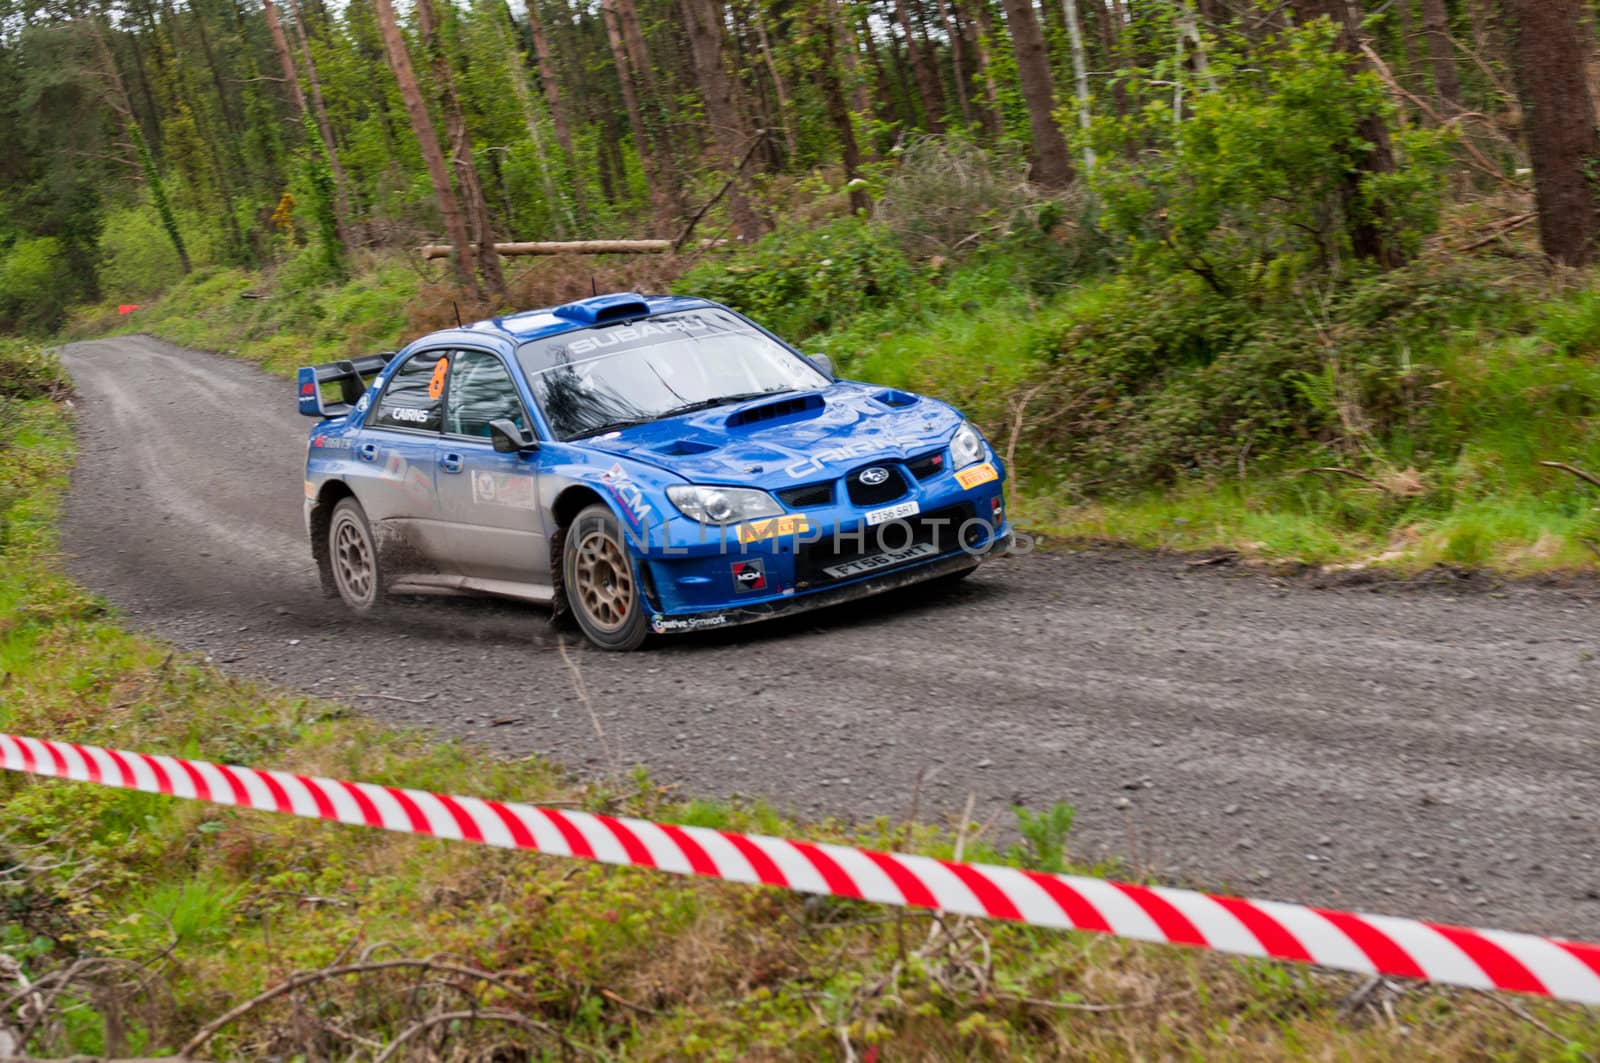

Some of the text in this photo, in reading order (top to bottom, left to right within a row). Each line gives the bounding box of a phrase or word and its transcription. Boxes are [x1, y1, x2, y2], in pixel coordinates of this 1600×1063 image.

[567, 316, 707, 355] SUBARU
[428, 357, 449, 400] 8
[392, 407, 429, 422] CAIRNS
[871, 503, 914, 522] FT56 SRT
[834, 555, 889, 576] FT56
